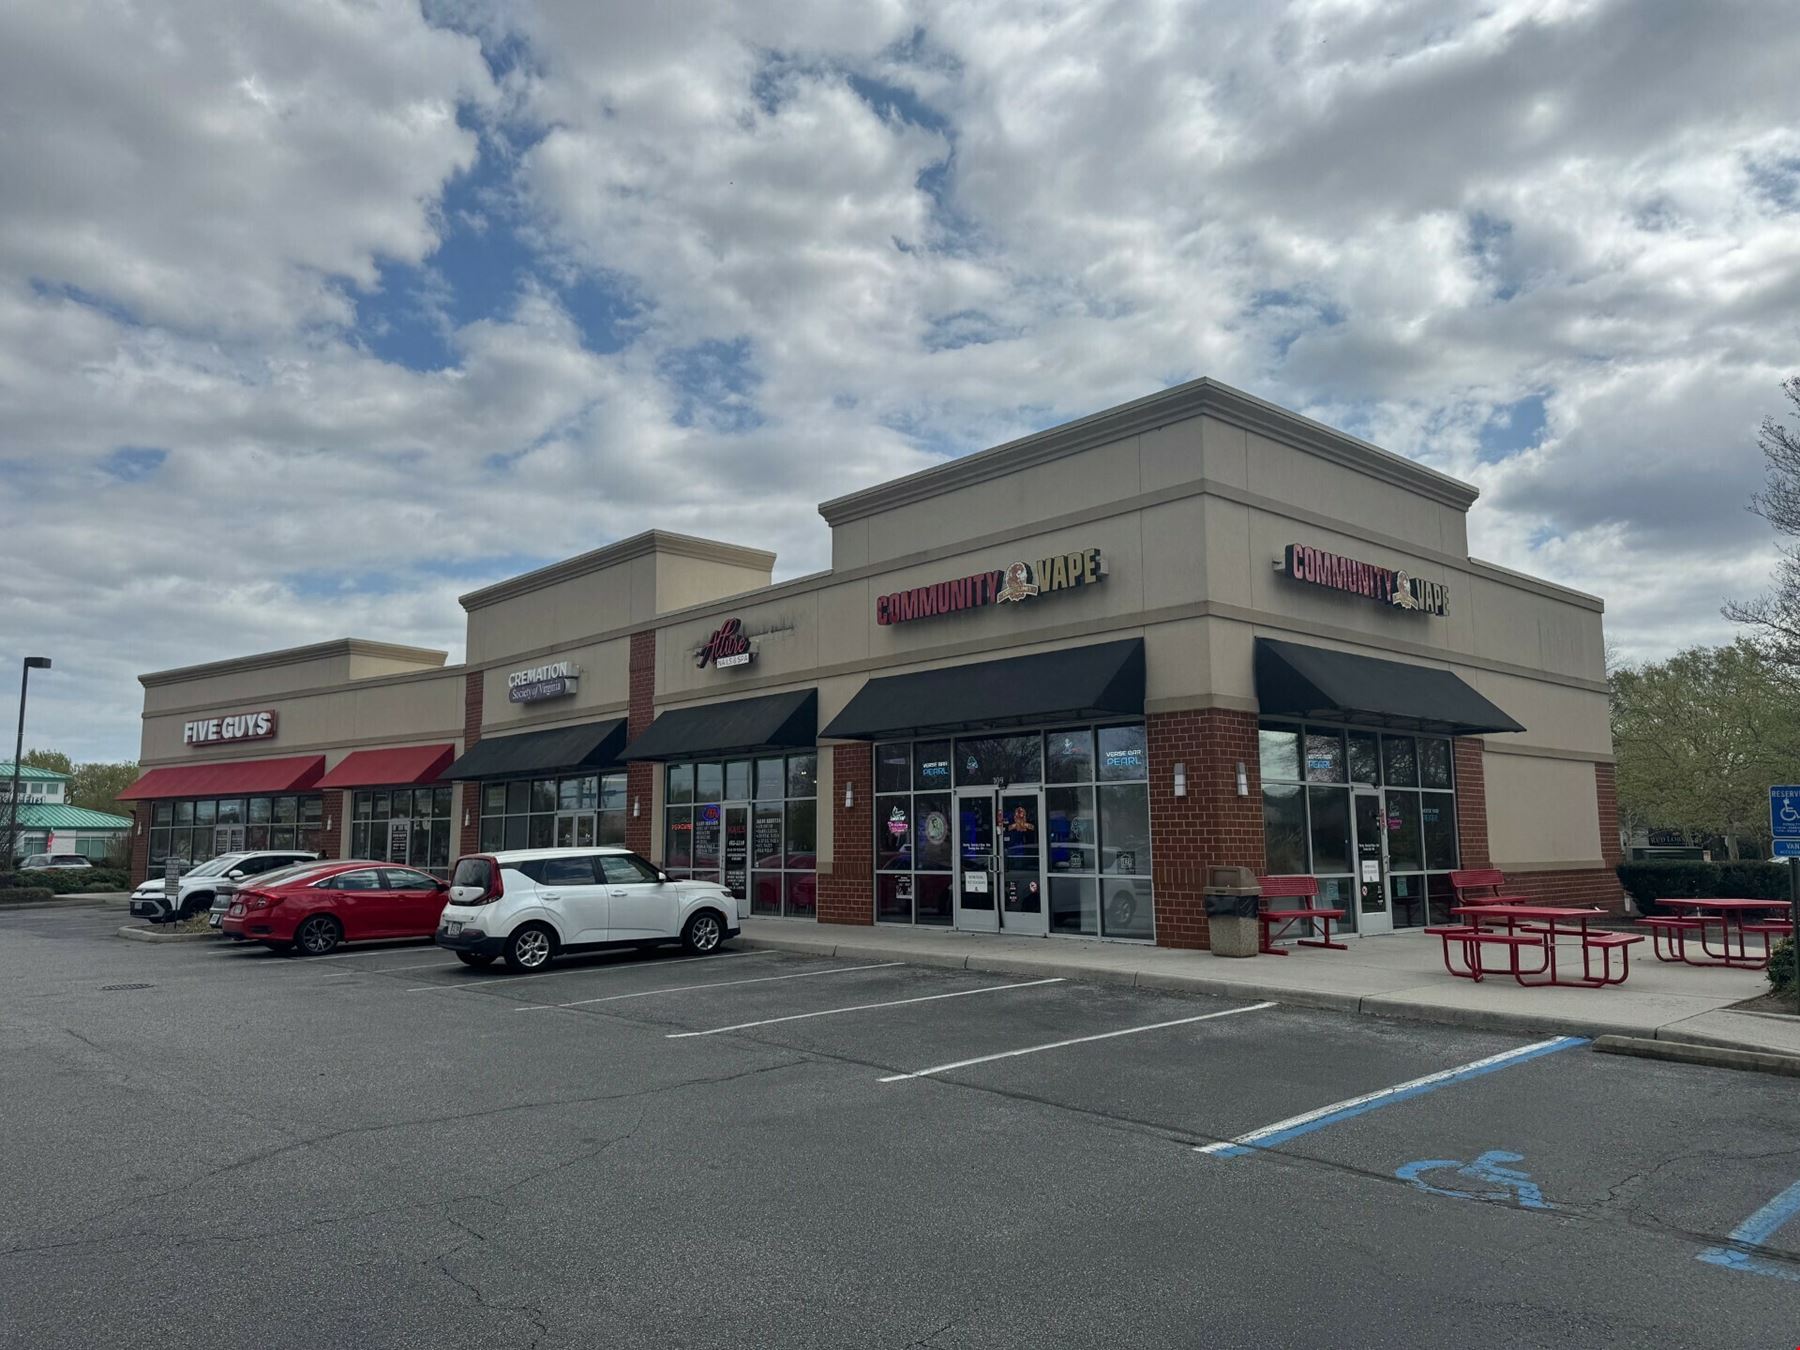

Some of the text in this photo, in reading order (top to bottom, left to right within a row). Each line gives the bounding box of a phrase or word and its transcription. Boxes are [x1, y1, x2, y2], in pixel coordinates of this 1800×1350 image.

[877, 548, 1099, 626] COMMUNITY VAPE
[1293, 543, 1450, 617] COMMUNITY VAPE
[698, 617, 750, 668] Allure
[737, 655, 749, 664] SPA
[508, 661, 568, 688] CREMATION
[512, 688, 532, 699] Society
[539, 680, 561, 696] Virginia
[183, 712, 272, 743] FIVE GUYS
[922, 767, 949, 776] PEARL
[1106, 756, 1142, 766] PEARL
